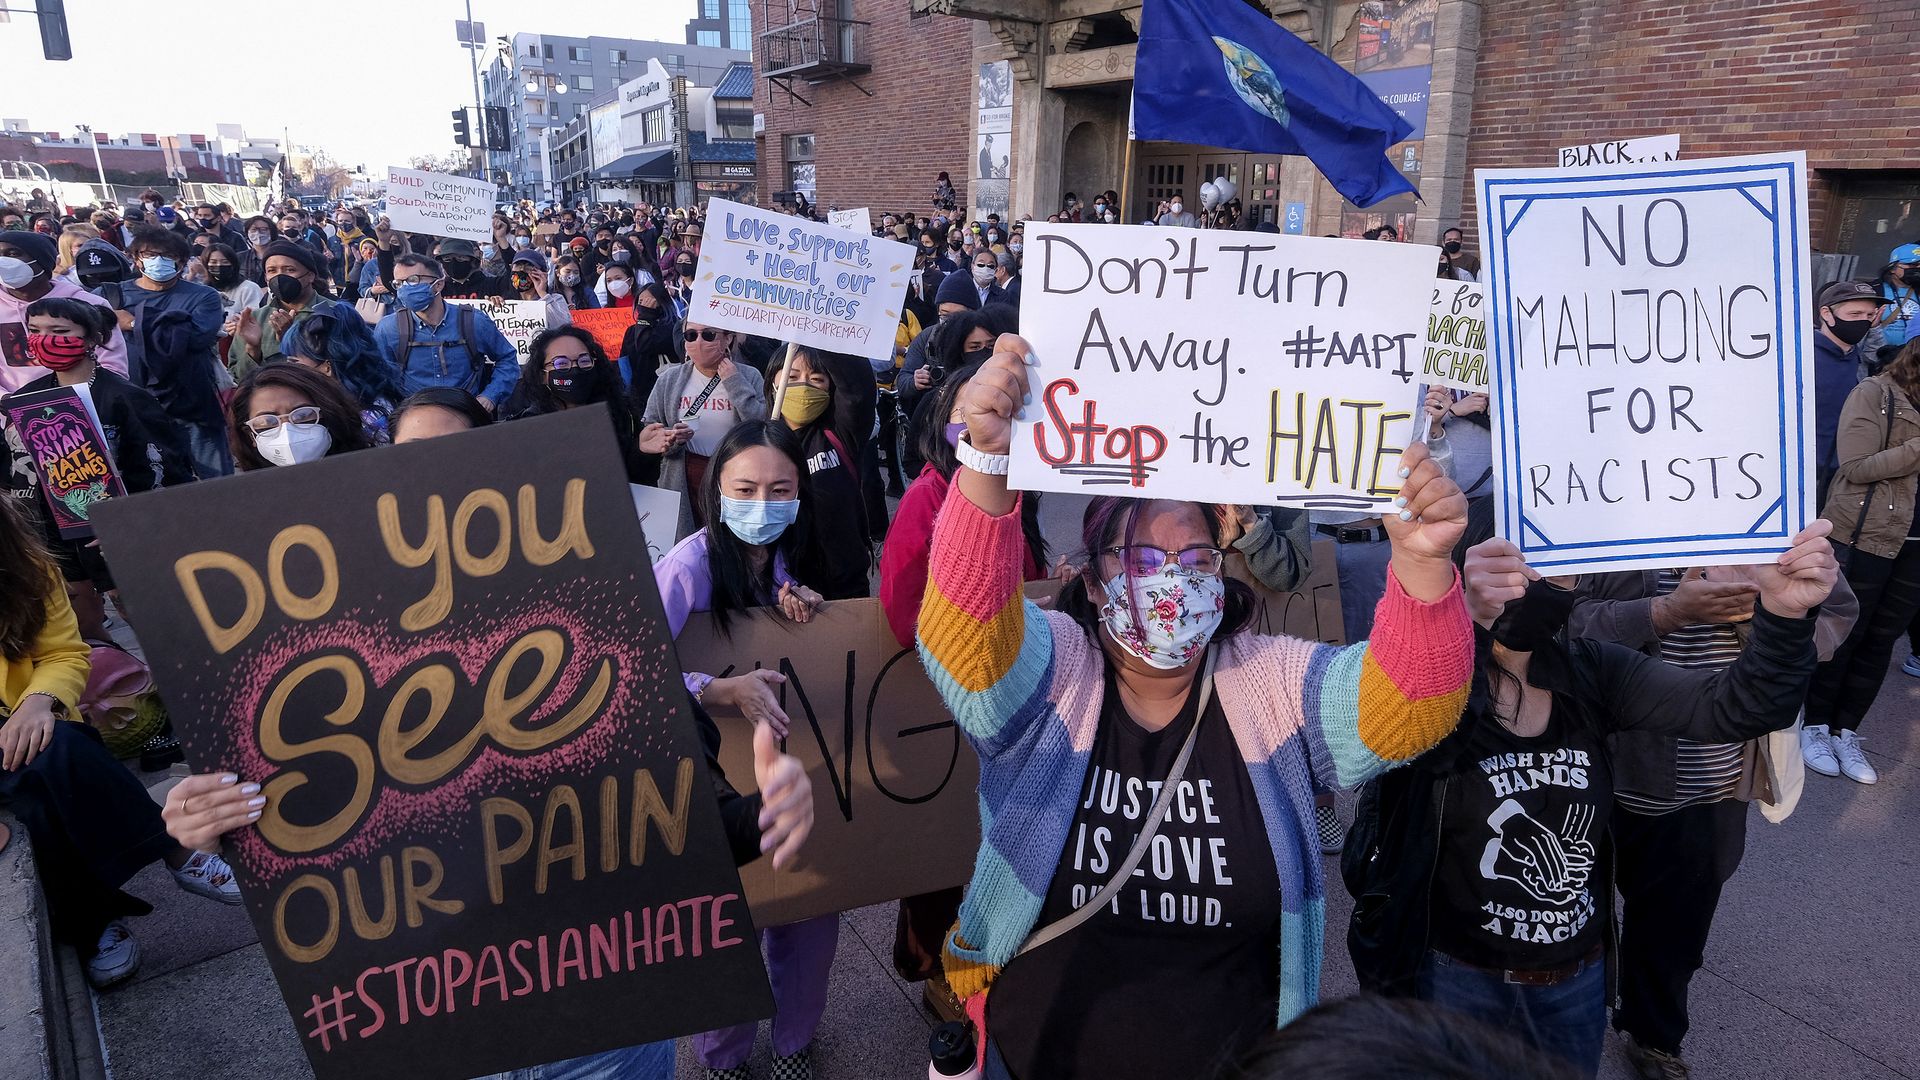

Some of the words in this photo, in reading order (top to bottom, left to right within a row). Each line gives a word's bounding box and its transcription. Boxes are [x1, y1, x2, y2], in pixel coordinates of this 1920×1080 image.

[1390, 92, 1421, 104] COURAGE
[1562, 142, 1632, 167] BLACK
[390, 173, 424, 188] BUILD
[432, 181, 495, 201] COMMUNITY
[424, 191, 466, 203] POWER!
[420, 209, 473, 221] WEAPON!
[464, 207, 486, 216] OUR
[833, 211, 858, 223] STOP
[1582, 197, 1689, 267] NO
[837, 272, 876, 294] our
[1037, 234, 1209, 299] Don't
[1219, 244, 1348, 307] Turn
[480, 302, 518, 318] RACIST
[715, 274, 860, 321] communities
[1516, 285, 1771, 369] MAHJONG
[1074, 307, 1246, 406] Away.
[1282, 325, 1417, 384] #AAPI
[690, 393, 707, 414] BAGGU
[1586, 385, 1703, 434] FOR
[31, 422, 65, 450] STOP
[38, 425, 86, 471] ASIAN
[1033, 378, 1168, 487] Stop
[1179, 411, 1250, 468] the
[1266, 387, 1412, 496] HATE
[47, 440, 96, 486] HATE
[58, 456, 108, 489] CRIMES
[1530, 452, 1765, 507] RACISTS
[174, 524, 340, 654] DO
[377, 478, 595, 632] YOU
[255, 628, 611, 852] See
[1479, 752, 1533, 774] WASH
[1540, 748, 1591, 767] YOUR
[1488, 765, 1589, 798] HANDS
[273, 846, 465, 963] OUR
[480, 757, 694, 905] PAIN
[1073, 822, 1112, 874] IS
[1140, 888, 1232, 928] LOUD.
[1481, 900, 1527, 921] ALSO
[1530, 903, 1580, 924] DON'T
[1481, 917, 1503, 936] A
[1510, 896, 1596, 944] RACIST
[304, 892, 743, 1051] #STOPASIANHATE
